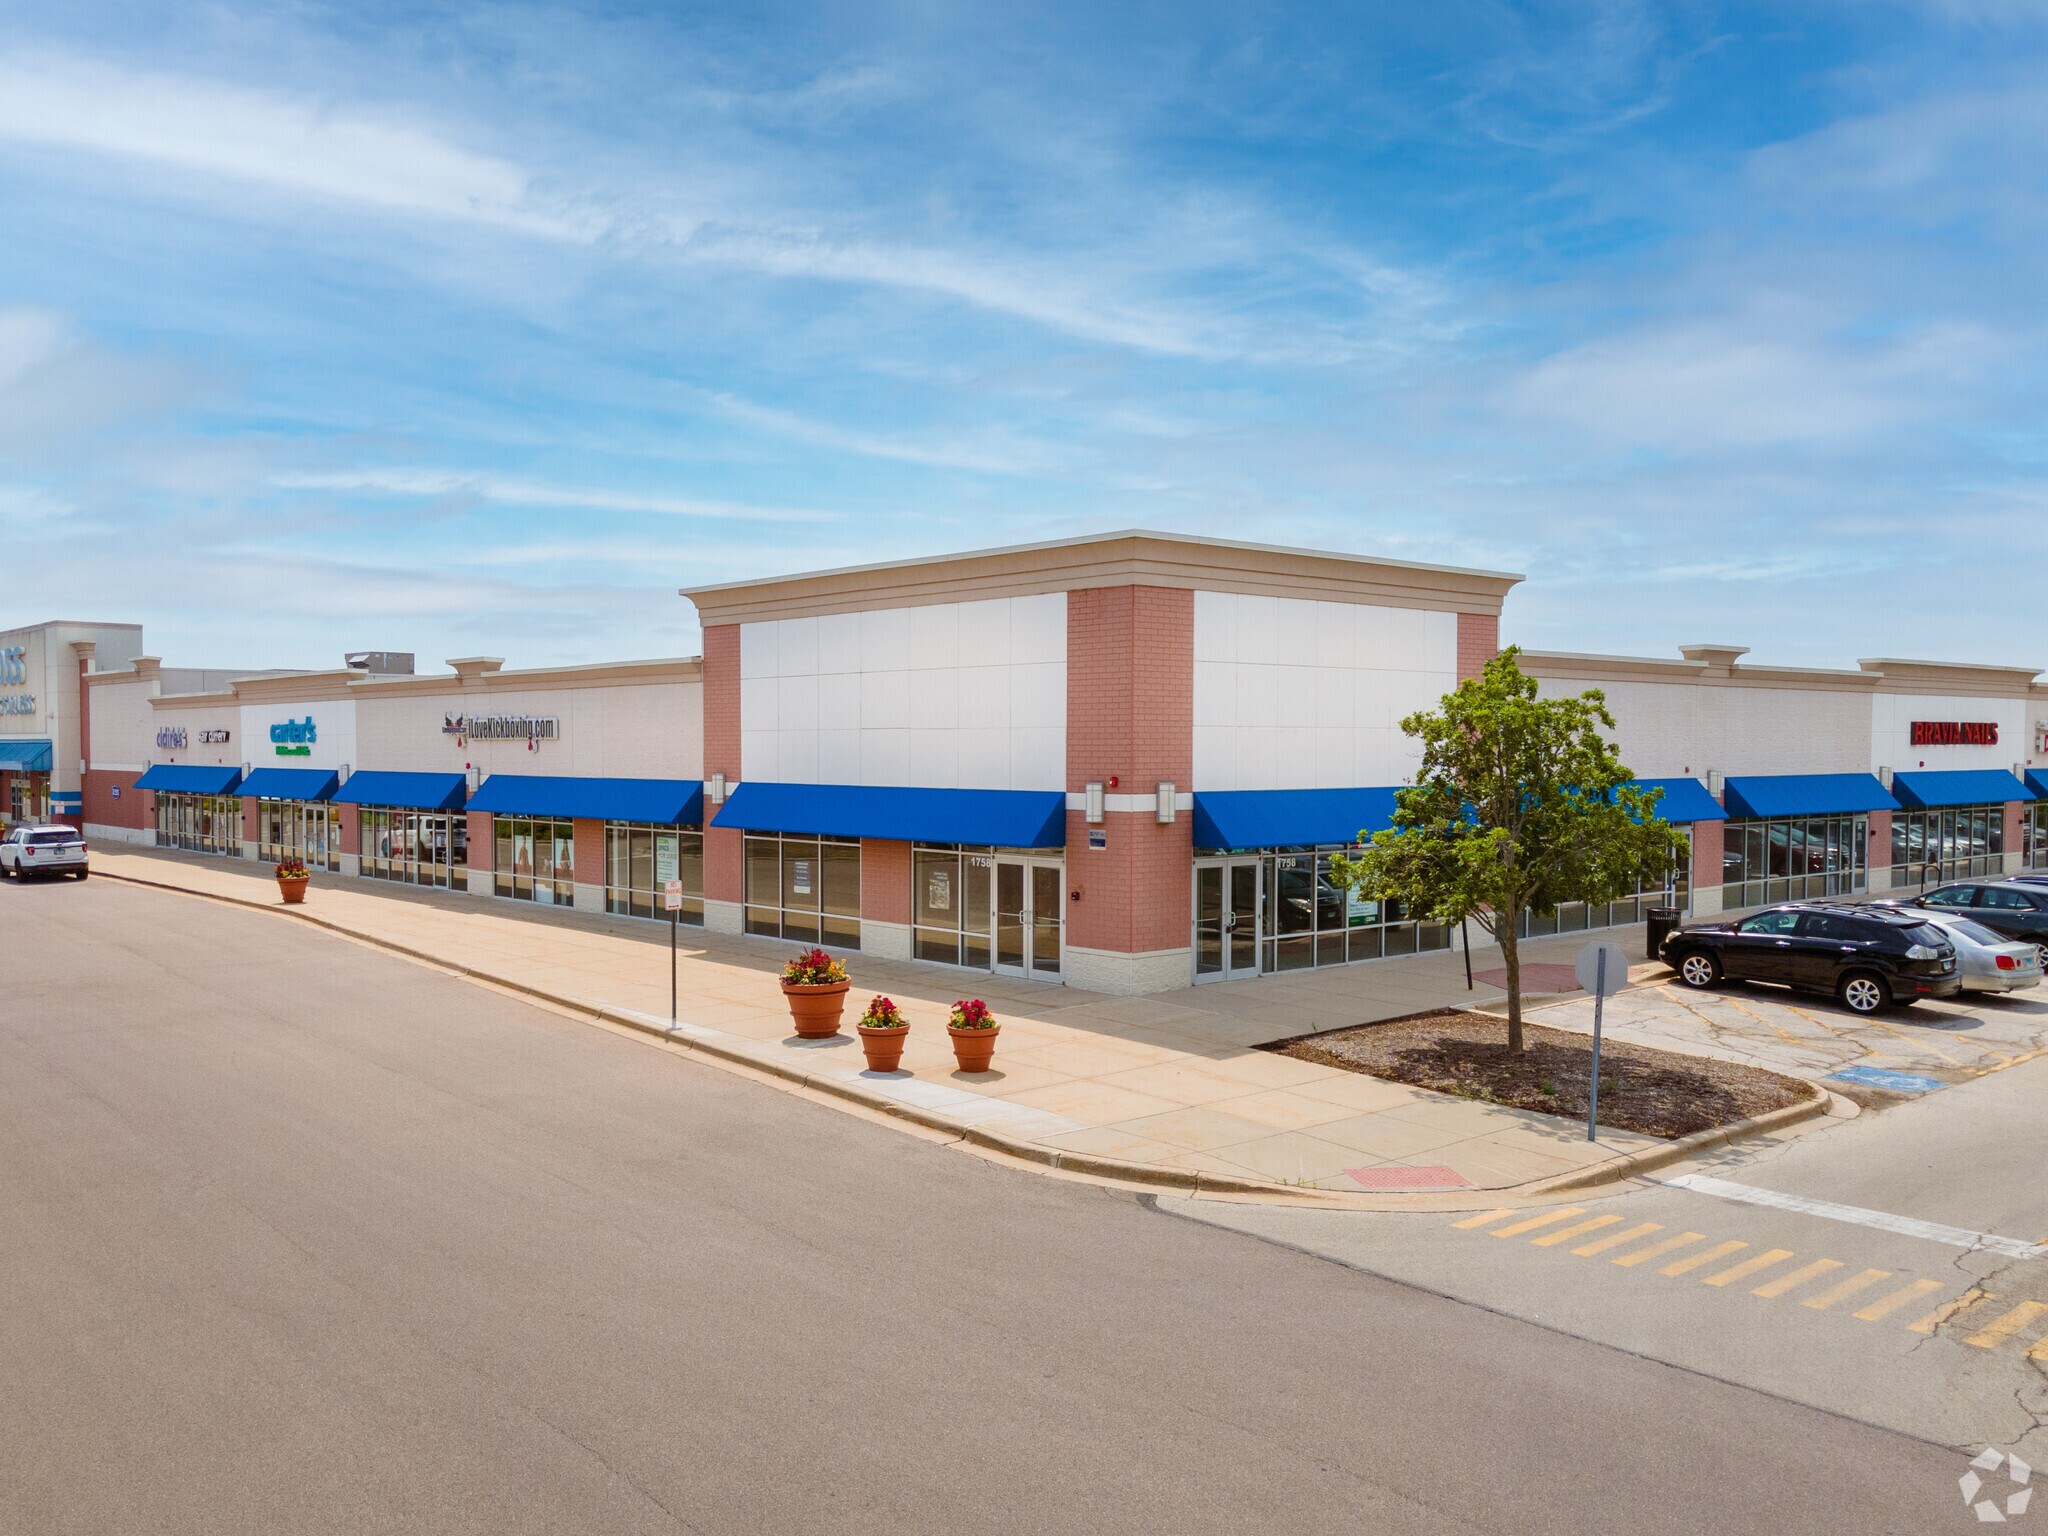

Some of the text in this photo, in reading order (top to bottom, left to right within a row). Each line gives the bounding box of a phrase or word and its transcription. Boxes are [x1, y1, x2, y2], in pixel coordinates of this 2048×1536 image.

[270, 716, 317, 743] carter's
[1912, 722, 1998, 745] BRAVIA NAILS
[971, 857, 991, 868] 1758
